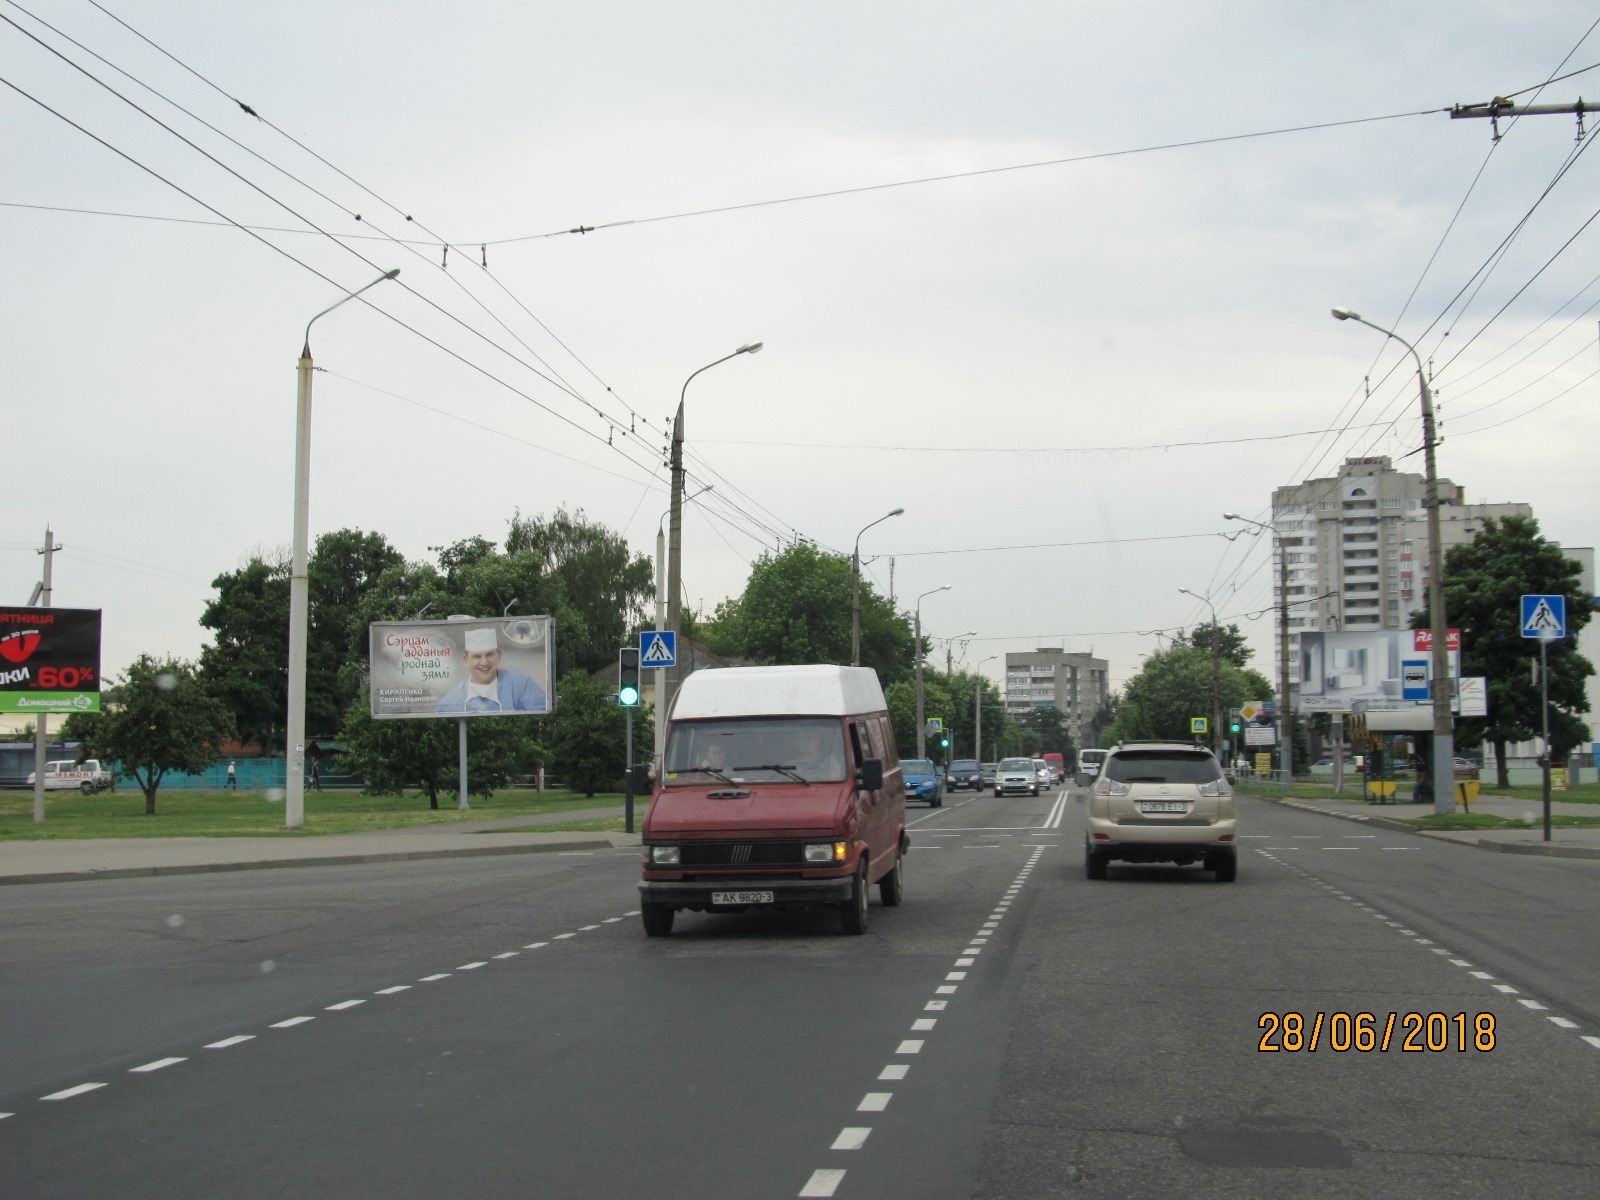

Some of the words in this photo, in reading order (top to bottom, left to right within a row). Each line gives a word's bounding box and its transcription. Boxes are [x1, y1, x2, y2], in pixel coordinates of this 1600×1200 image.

[386, 633, 430, 652] Сэрцам
[404, 645, 451, 658] адданыя
[401, 657, 441, 676] роднай
[421, 667, 450, 682] зямлі
[380, 688, 423, 696] КИРИЛЕНКО
[17, 696, 72, 707] Домашний
[380, 695, 404, 704] Сергей
[722, 893, 737, 903] AK
